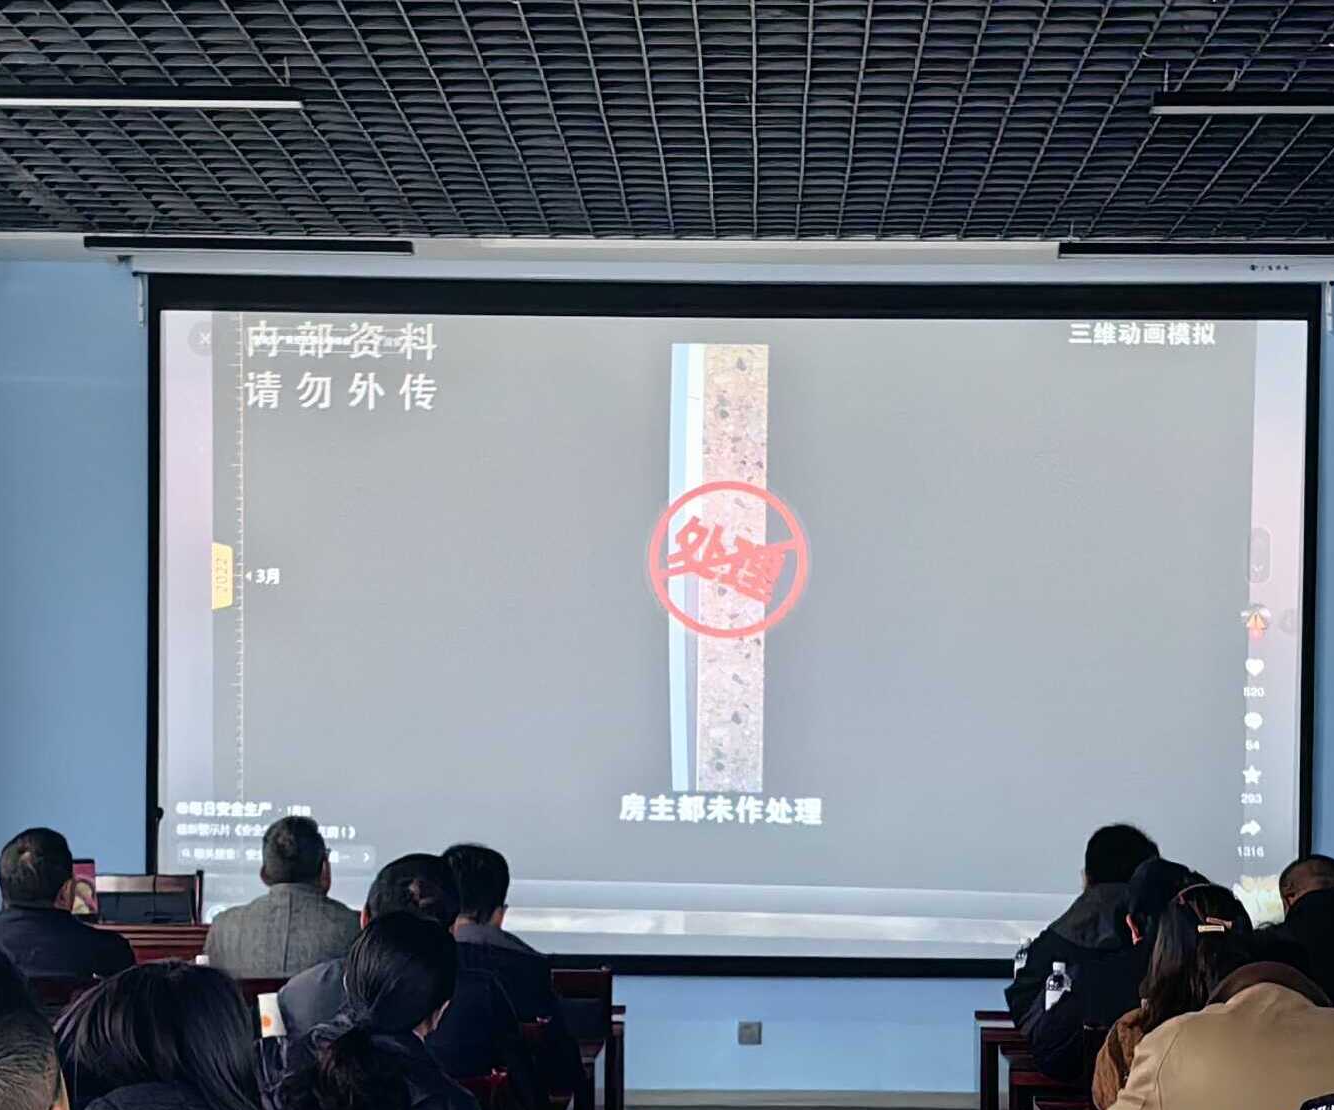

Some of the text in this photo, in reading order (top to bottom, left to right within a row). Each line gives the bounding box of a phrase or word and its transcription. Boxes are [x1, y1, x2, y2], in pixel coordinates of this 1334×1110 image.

[1068, 321, 1216, 346] 三维动画模拟
[244, 370, 437, 411] 请勿外传
[255, 567, 280, 585] 3月
[619, 793, 822, 825] 房主都未作处理
